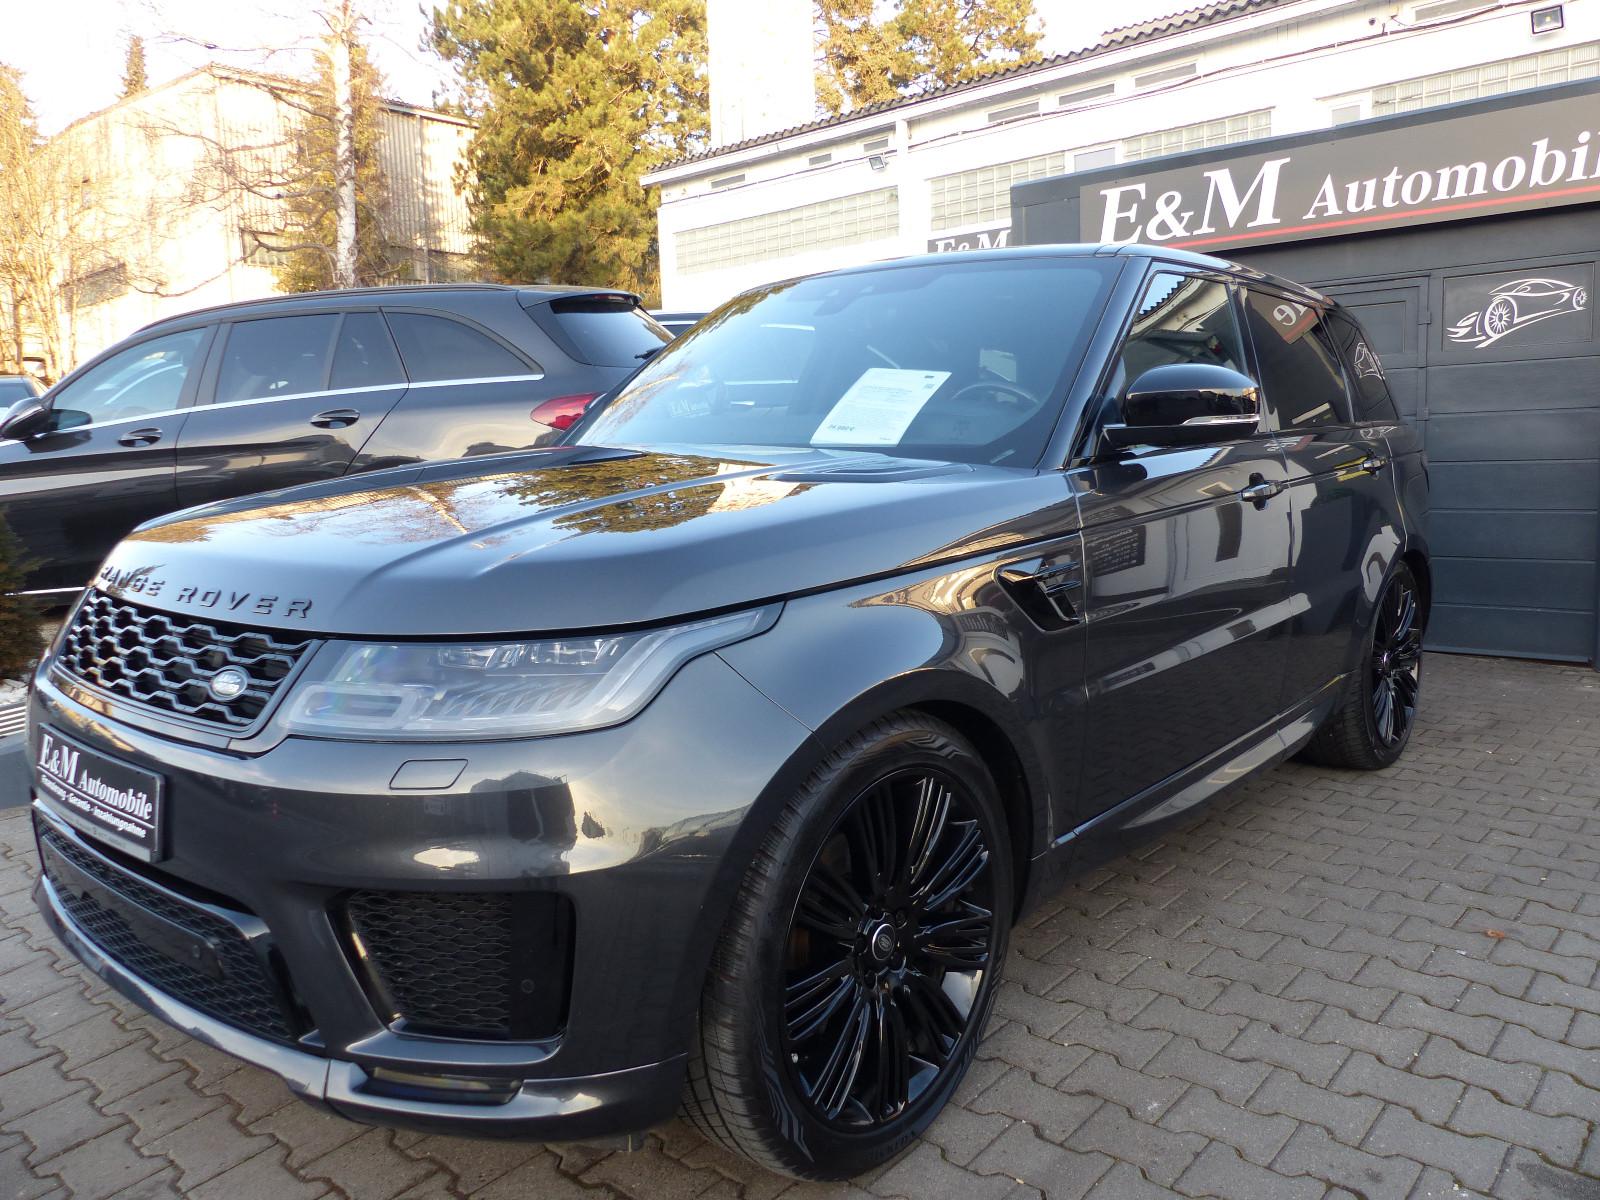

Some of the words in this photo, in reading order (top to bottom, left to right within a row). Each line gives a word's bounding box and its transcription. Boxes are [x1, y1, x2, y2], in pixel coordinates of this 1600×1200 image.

[1098, 157, 1291, 246] E&M
[100, 564, 166, 597] RANGE
[176, 586, 313, 618] ROVER
[39, 734, 80, 785] E&M
[79, 768, 153, 820] Automobile
